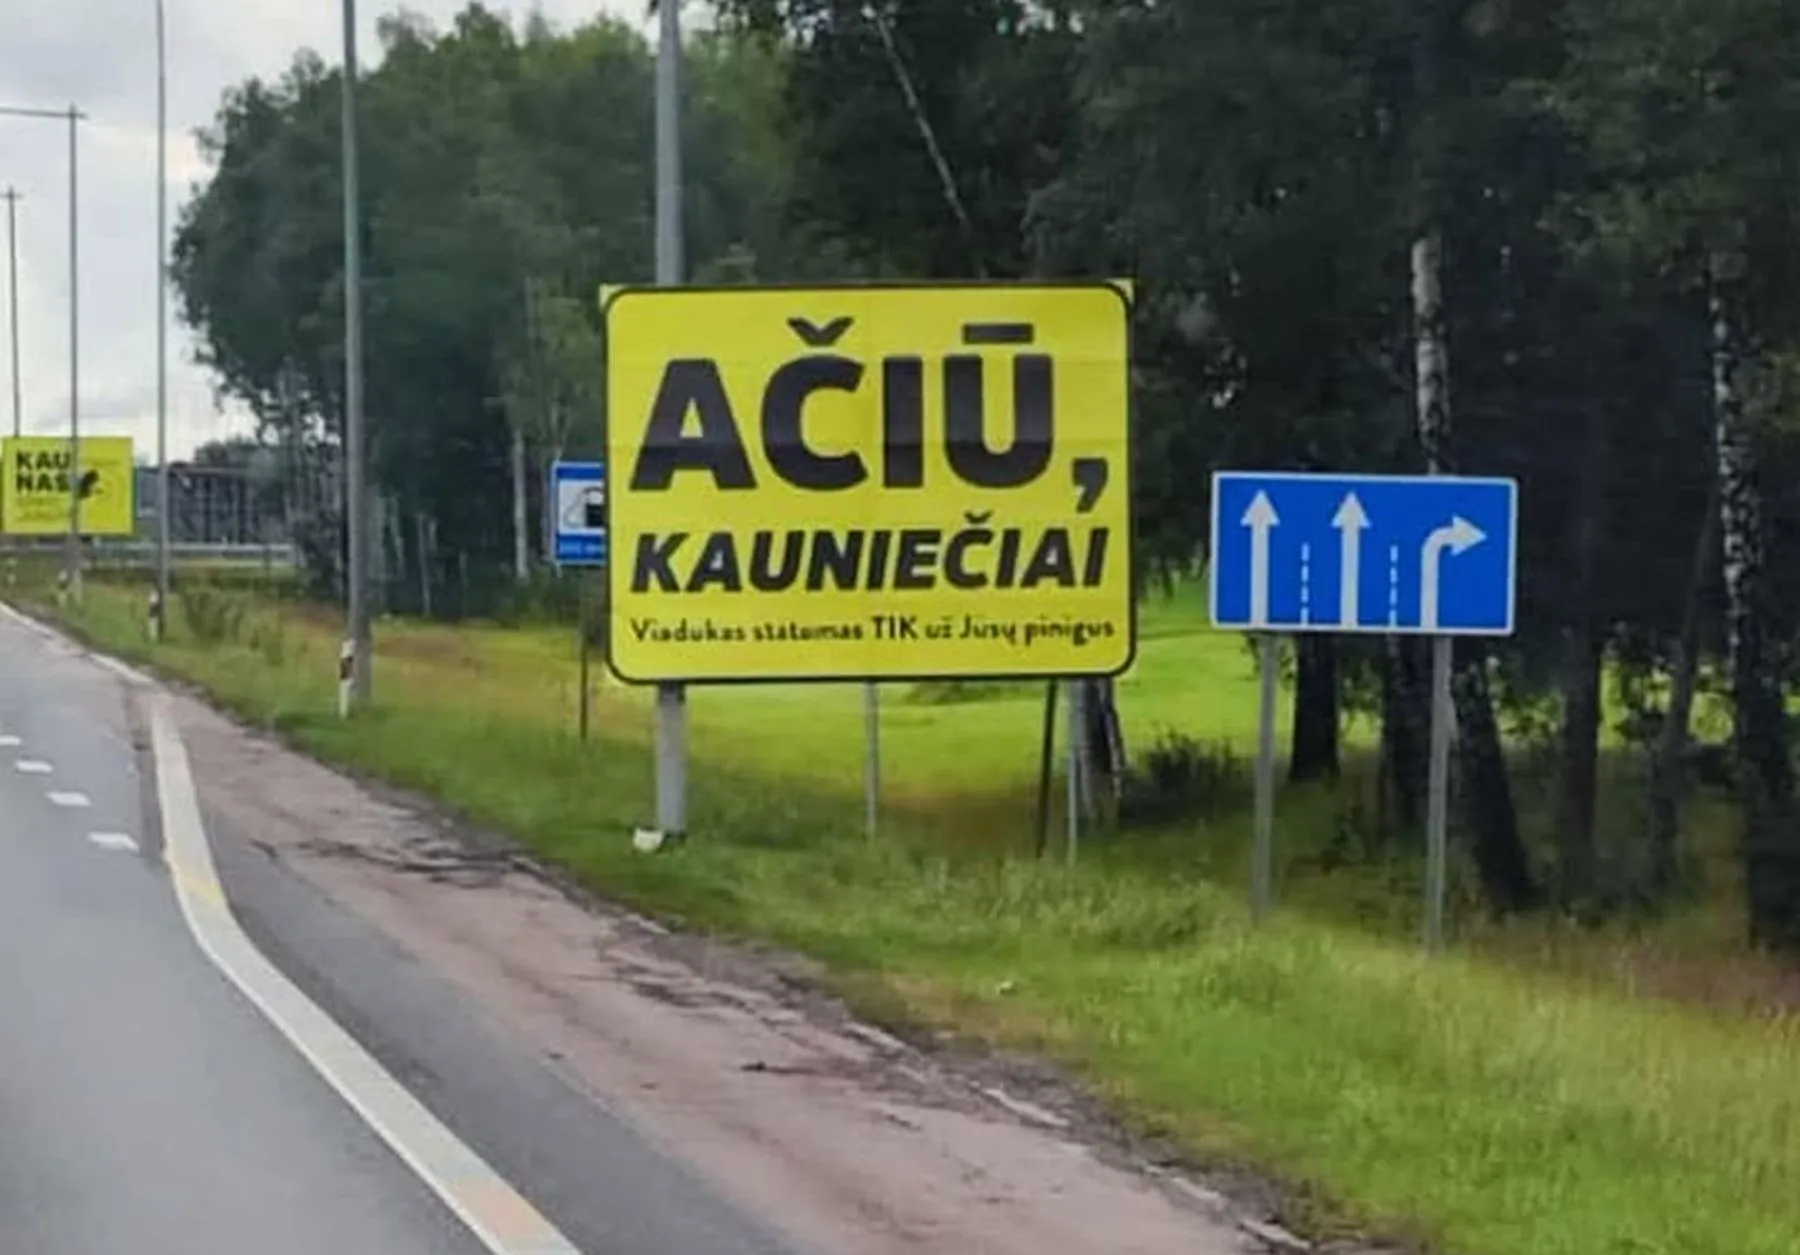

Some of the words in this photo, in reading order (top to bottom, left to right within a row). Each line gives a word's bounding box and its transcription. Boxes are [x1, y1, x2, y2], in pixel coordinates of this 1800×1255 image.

[630, 316, 1109, 513] AČIŪ,
[16, 451, 71, 470] KAU
[630, 511, 1109, 594] KAUNIEČIAI
[630, 617, 746, 642] Viadukas
[872, 615, 918, 639] TIK
[924, 615, 954, 639] už
[1023, 614, 1115, 646] pinigus
